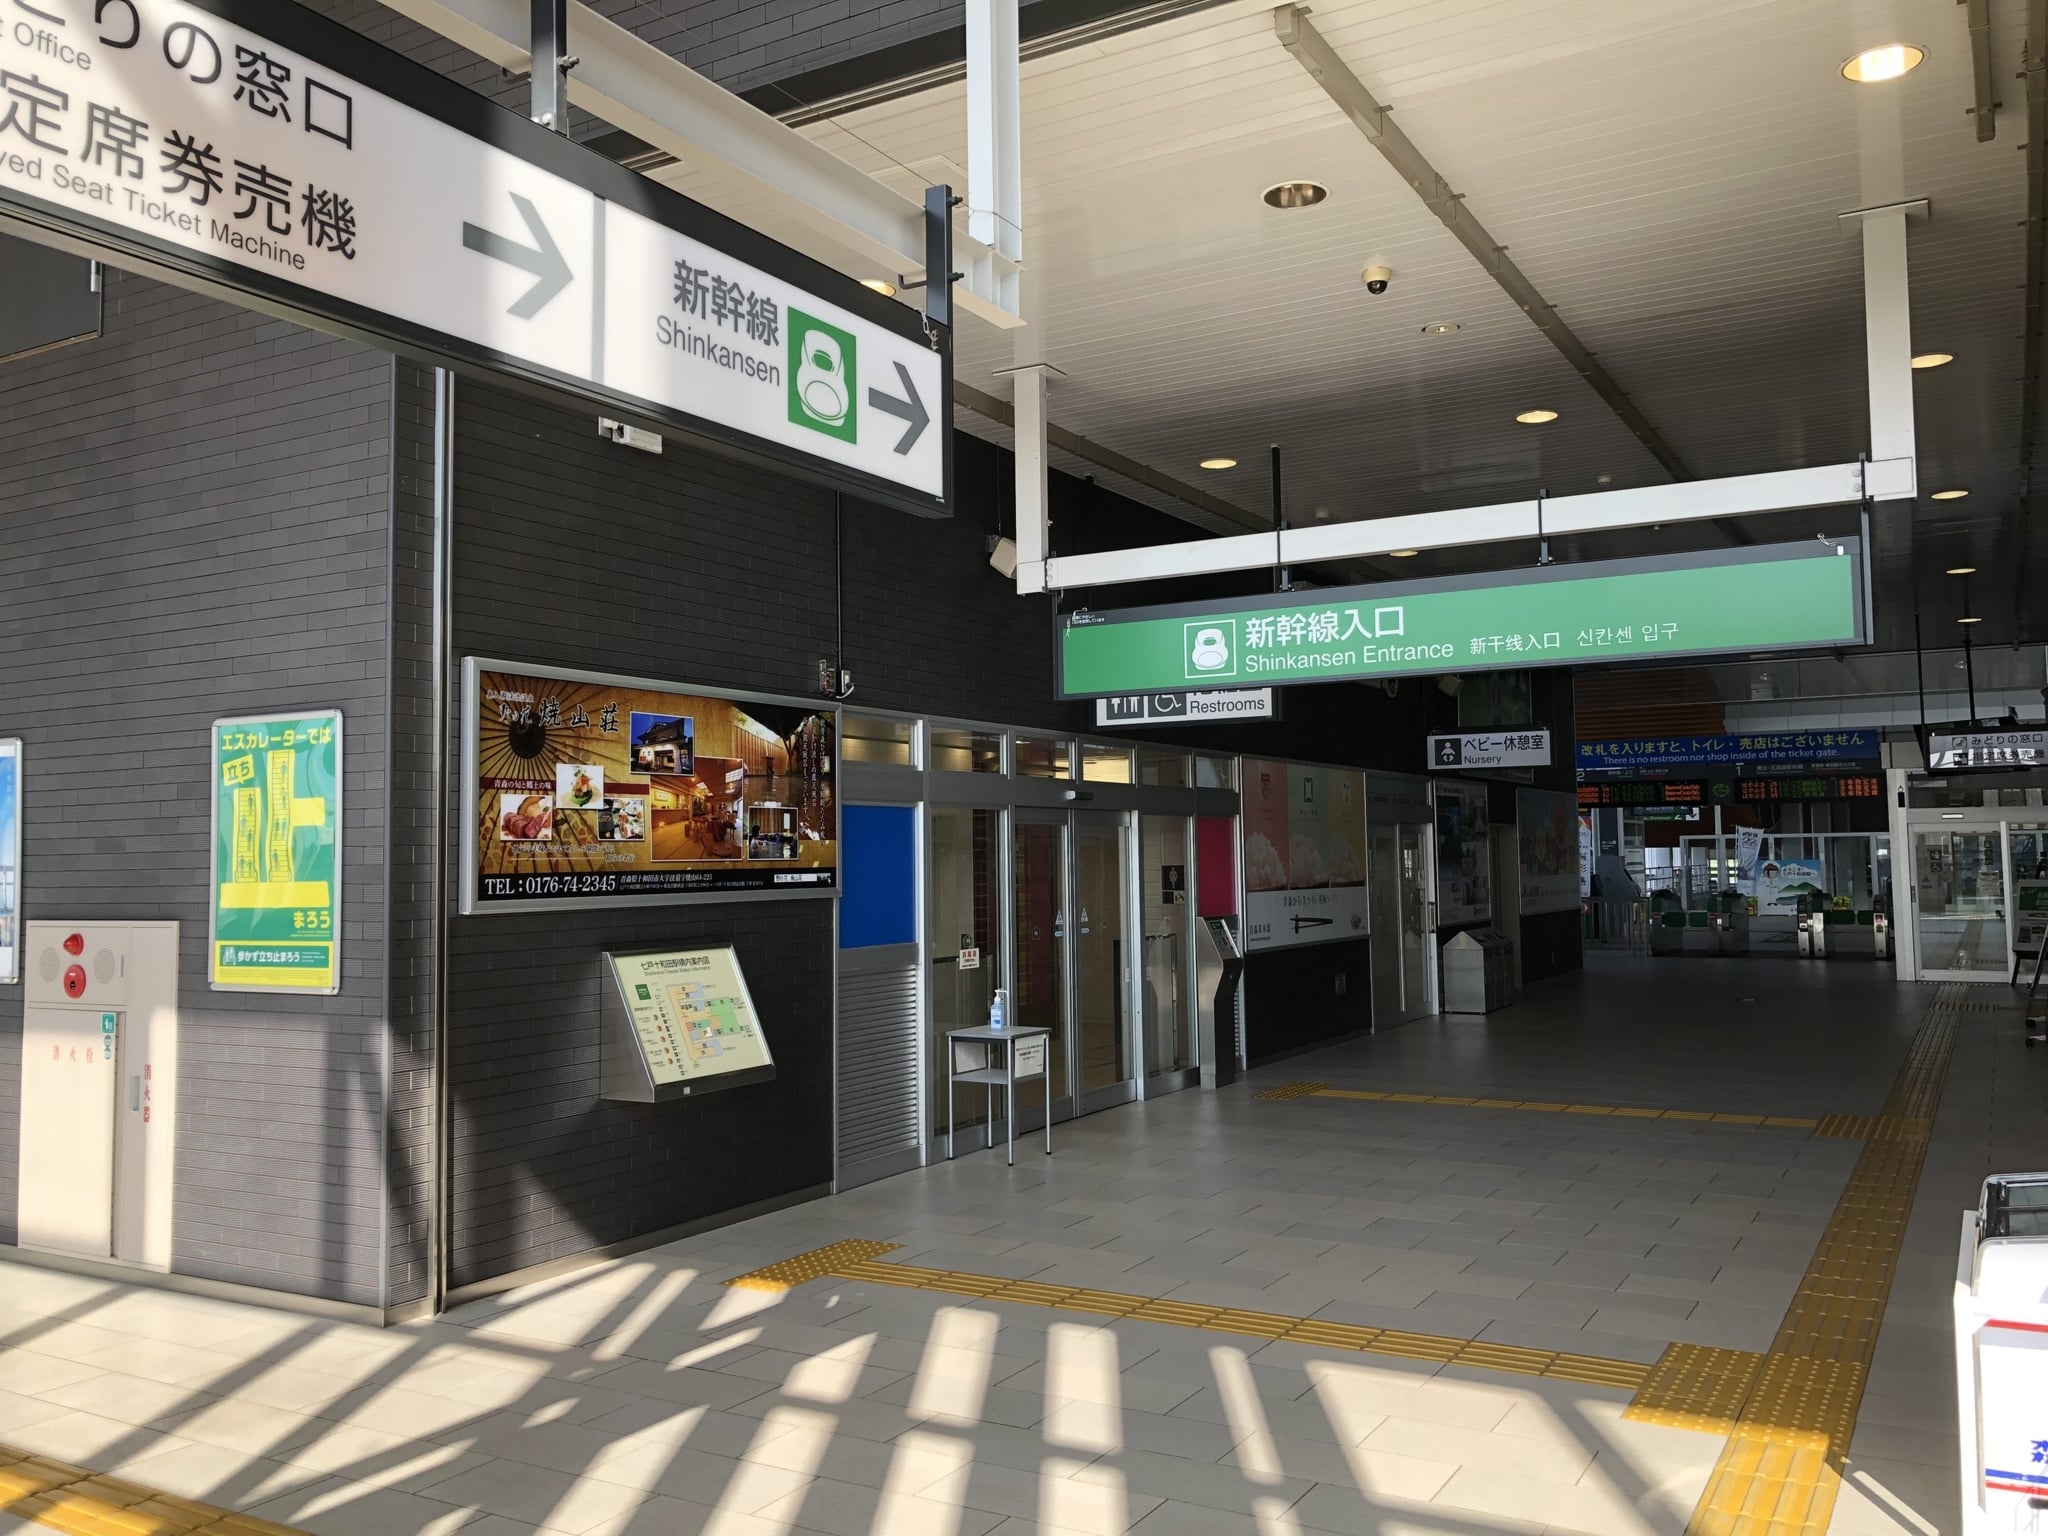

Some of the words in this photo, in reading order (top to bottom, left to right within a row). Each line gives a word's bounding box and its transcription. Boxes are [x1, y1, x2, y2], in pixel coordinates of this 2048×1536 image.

[13, 20, 92, 72] Office
[3, 0, 353, 150] りの窓口
[52, 162, 114, 206] Seat
[122, 187, 202, 236] Ticket
[210, 218, 306, 271] Machine
[673, 258, 780, 347] 新幹線
[656, 314, 781, 388] Shinkansen
[1245, 605, 1405, 649] 新幹線入口
[1576, 625, 1633, 648] 신칸센
[1641, 622, 1680, 643] 입구
[1469, 632, 1561, 656] 新干线入口
[1245, 650, 1356, 674] Shinkansen
[1362, 641, 1454, 664] Entrance
[1190, 697, 1266, 715] Restrooms
[222, 727, 331, 751] エスカレーターでは
[1463, 734, 1545, 752] ベビー休憩室
[1971, 734, 2044, 746] みどりの窓口
[1464, 755, 1502, 766] Nursery
[1603, 756, 1627, 765] There
[1628, 756, 1636, 764] is
[1637, 756, 1648, 764] no
[1650, 754, 1688, 763] restroom
[1690, 753, 1705, 762] nor
[1706, 752, 1729, 762] shop
[1730, 750, 1757, 760] inside
[1758, 749, 1768, 759] of
[1771, 749, 1786, 759] the
[1788, 748, 1814, 758] ticket
[227, 760, 250, 782] 立ち
[293, 910, 331, 929] まろう
[143, 1063, 152, 1123] 消火器
